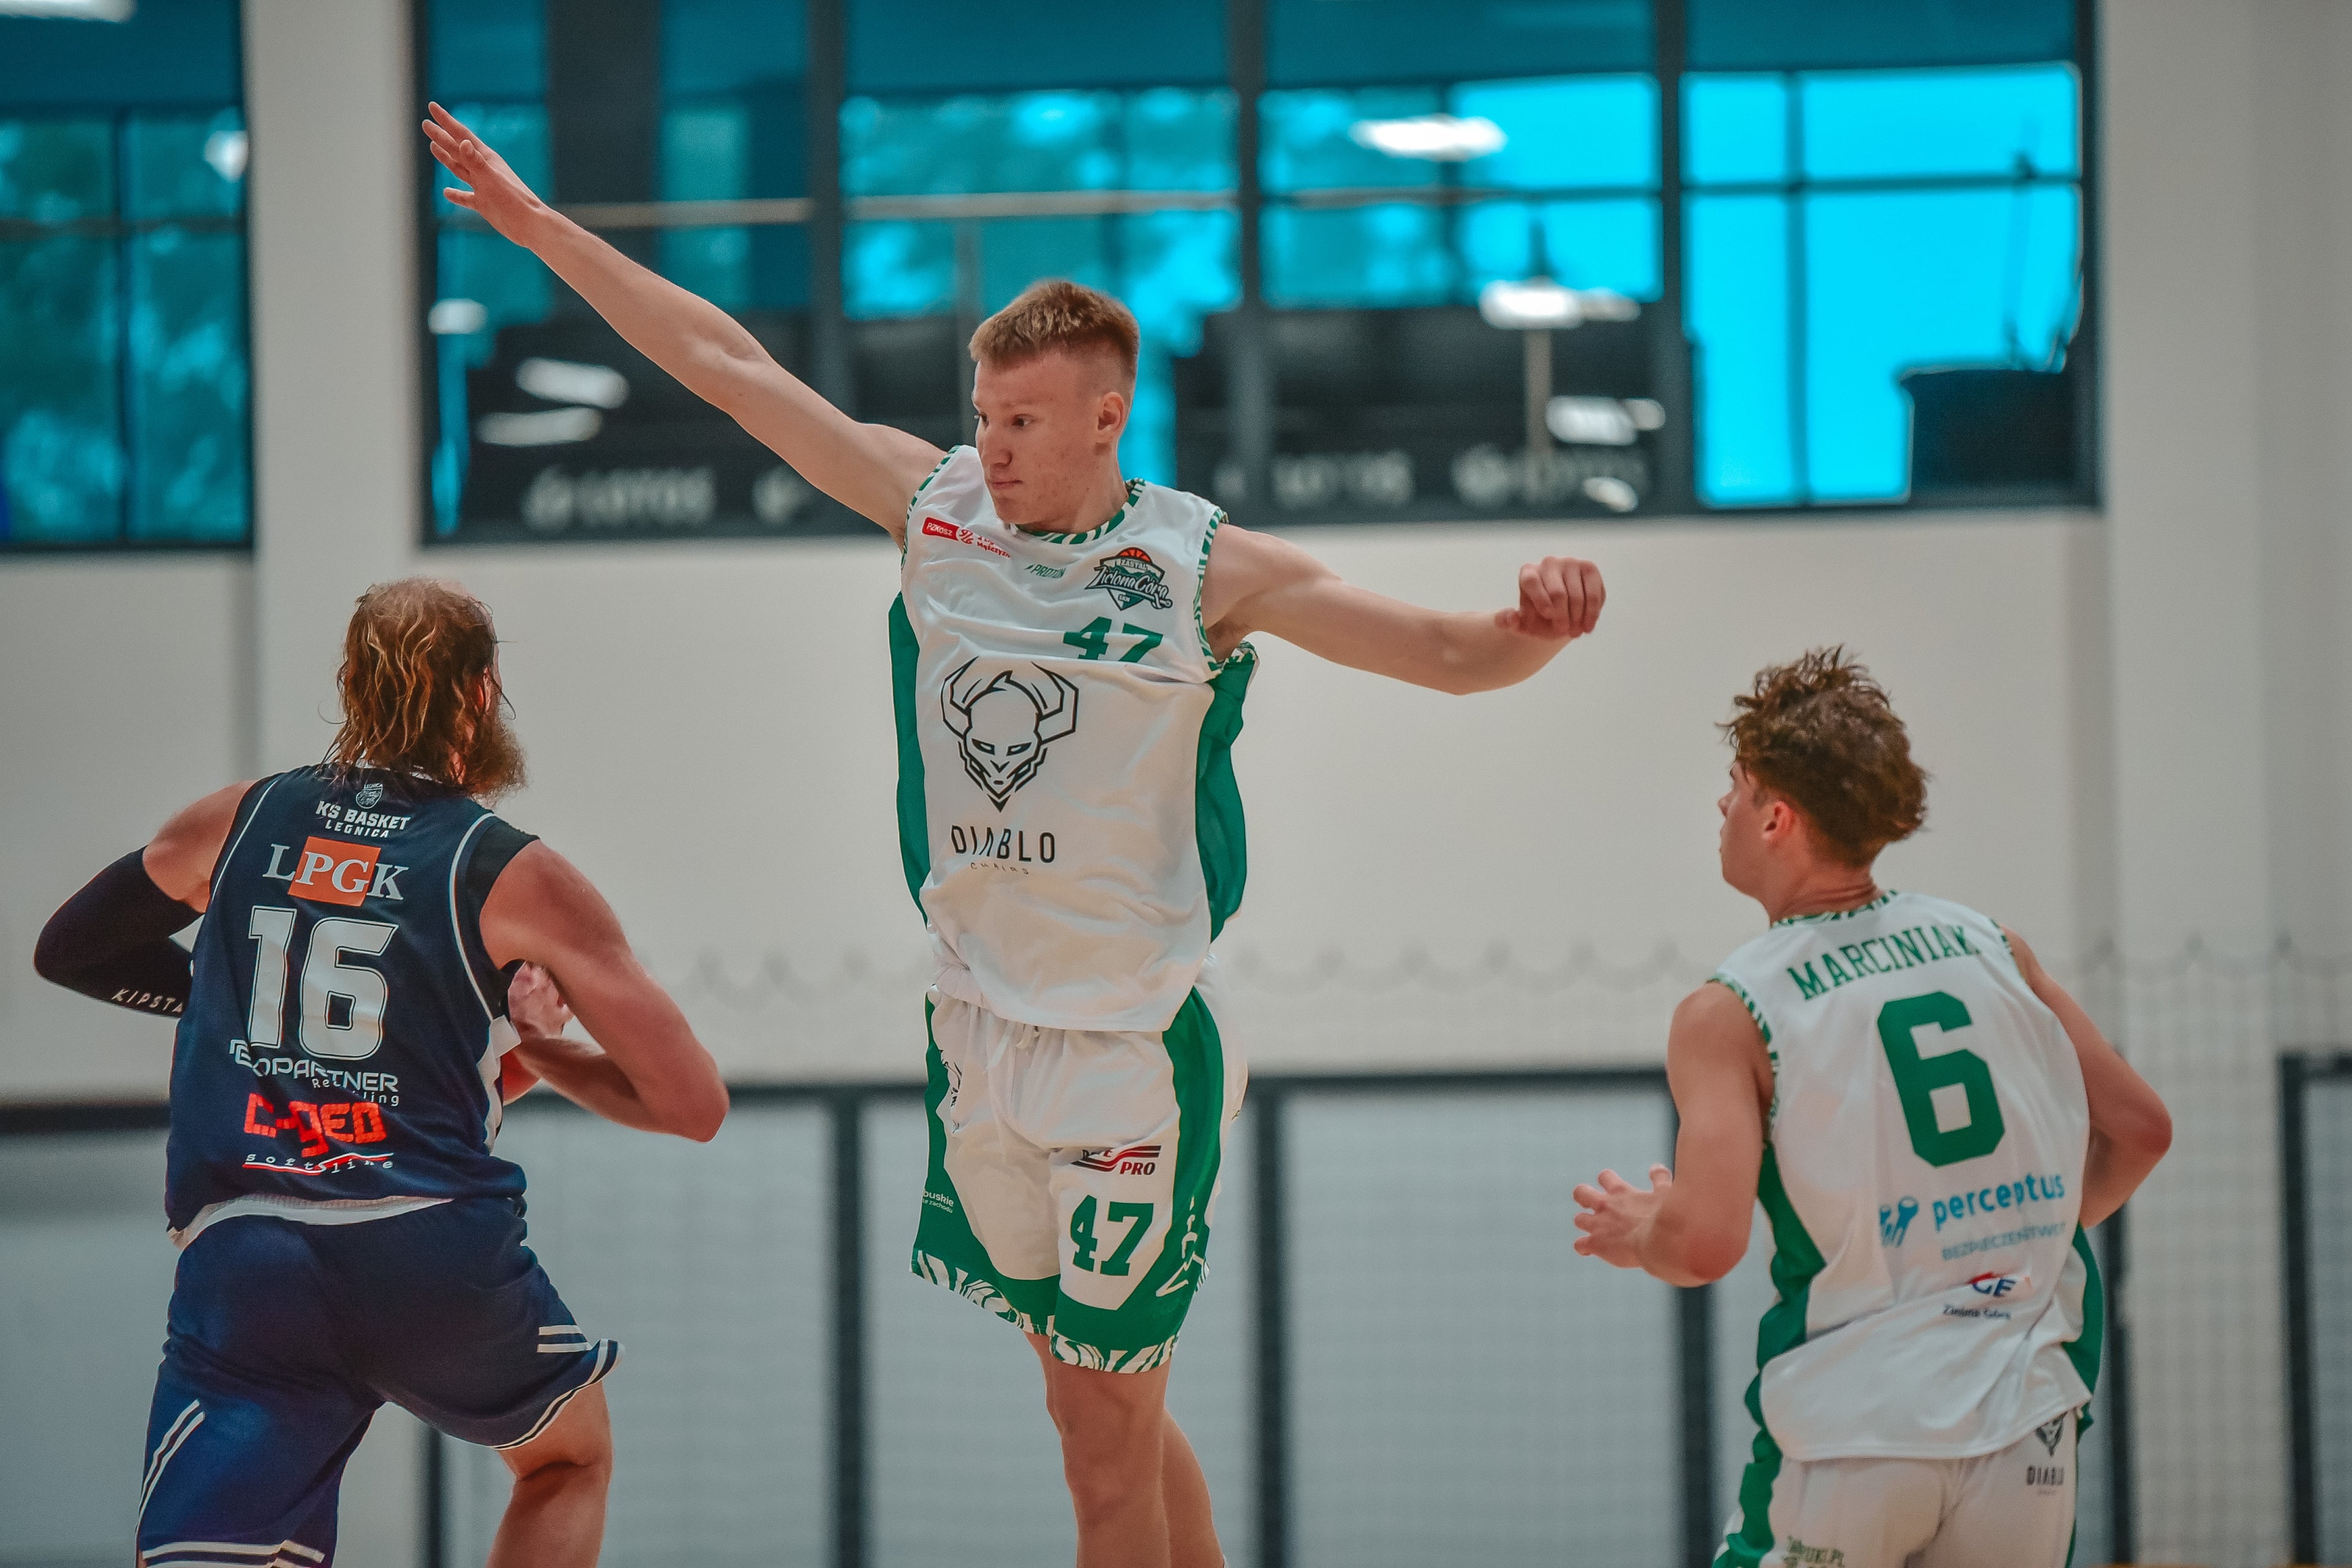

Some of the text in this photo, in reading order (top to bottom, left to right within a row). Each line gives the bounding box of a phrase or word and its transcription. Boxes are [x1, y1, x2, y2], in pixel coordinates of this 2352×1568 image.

[926, 522, 953, 537] PZKOSZ
[1063, 616, 1163, 662] 47
[315, 800, 411, 830] KS BASKET
[324, 820, 390, 839] LEGNICA
[951, 824, 1055, 863] DIABLO
[262, 843, 409, 900] LPGK
[247, 905, 399, 1061] 16
[1787, 925, 1981, 1001] MARCINIAK
[111, 988, 183, 1013] KIPSTA
[1877, 991, 2005, 1169] 6
[1120, 1161, 1156, 1175] PRO
[929, 1200, 953, 1213] zachodu
[1932, 1173, 2065, 1233] perceptus
[1069, 1195, 1154, 1276] 47
